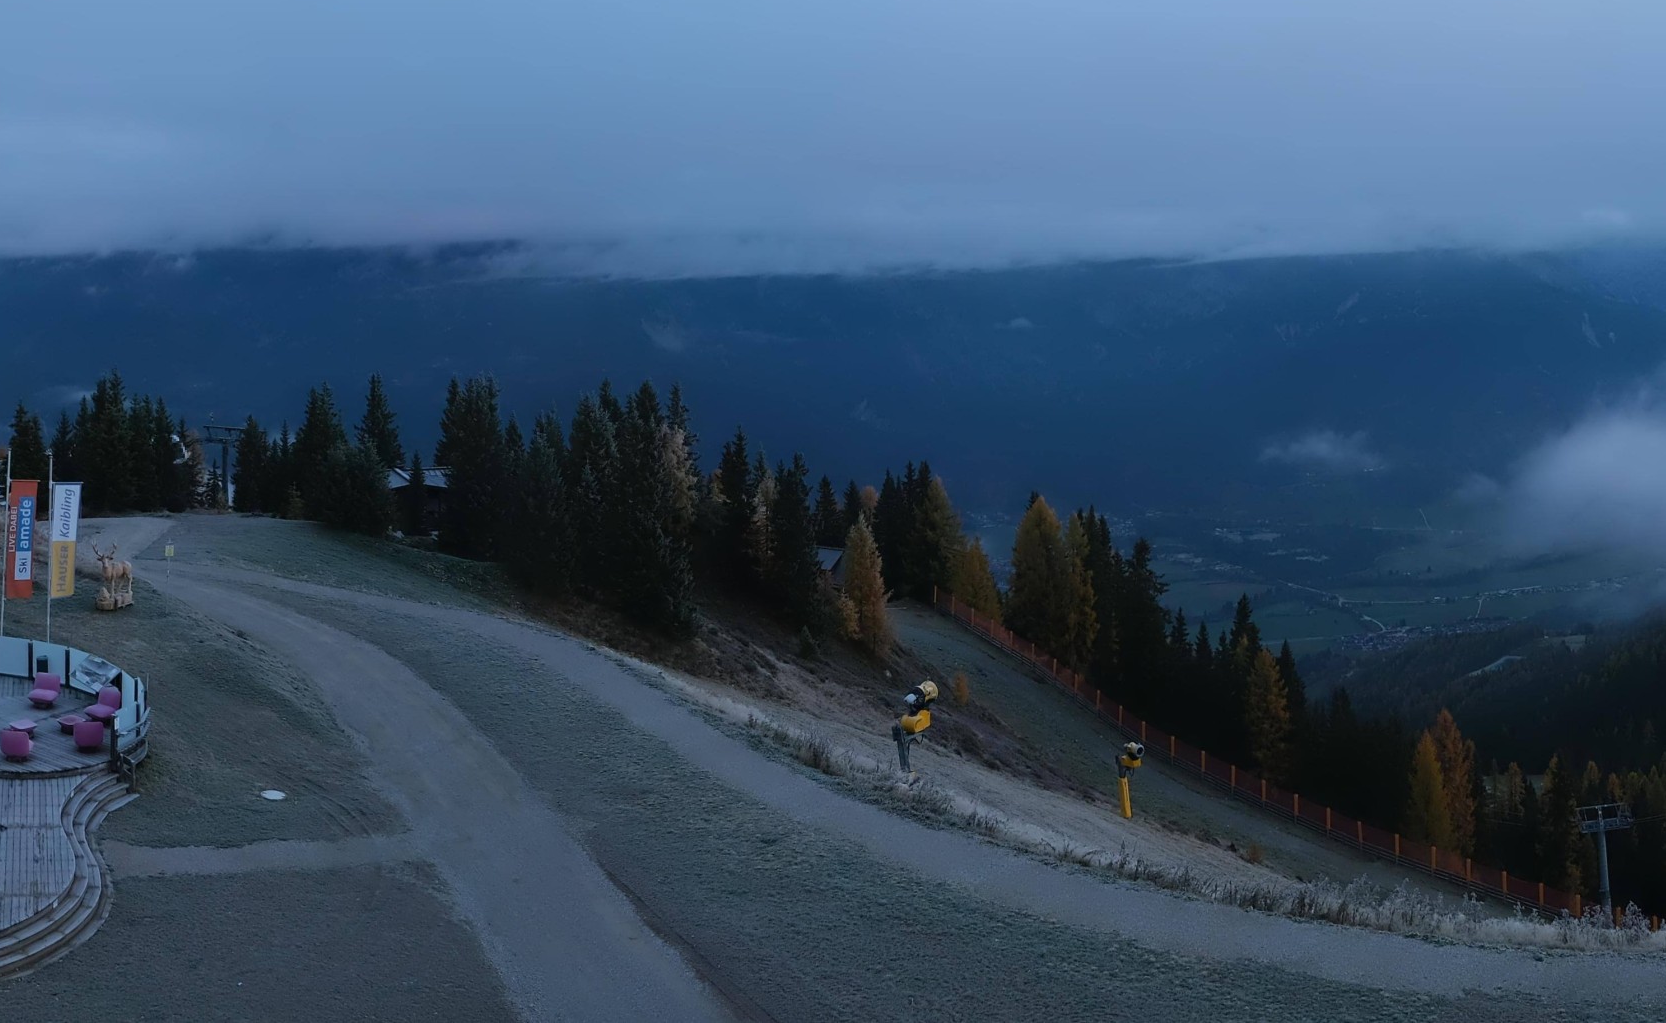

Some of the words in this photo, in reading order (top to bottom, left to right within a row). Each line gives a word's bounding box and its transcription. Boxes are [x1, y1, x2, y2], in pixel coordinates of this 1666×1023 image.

[10, 506, 18, 531] DABEI
[59, 488, 76, 538] Kaibling
[19, 557, 27, 573] Ski
[56, 545, 69, 592] HAUSER
